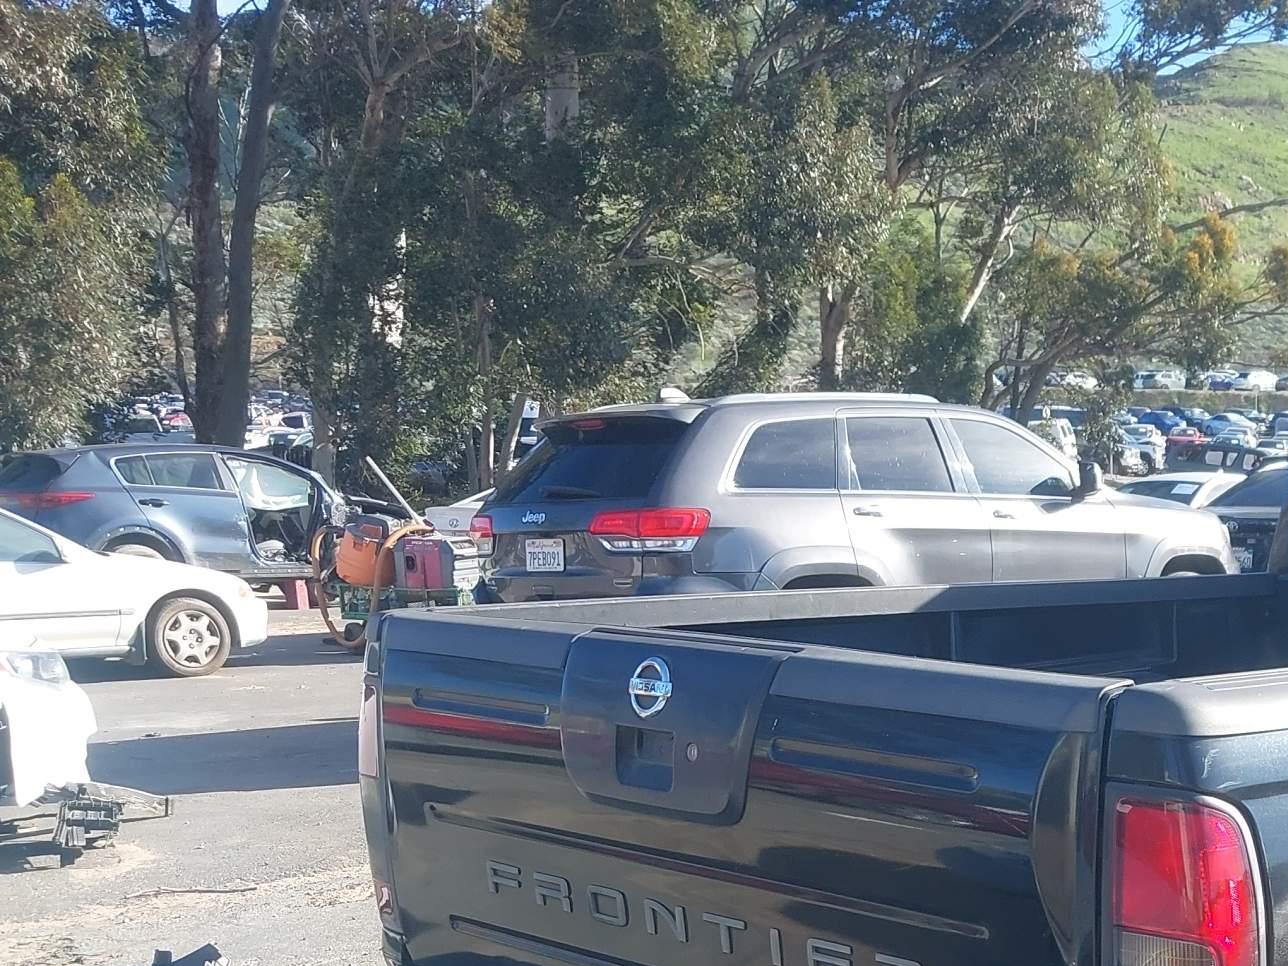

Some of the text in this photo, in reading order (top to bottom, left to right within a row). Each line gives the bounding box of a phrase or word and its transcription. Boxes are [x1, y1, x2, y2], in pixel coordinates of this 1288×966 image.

[522, 510, 546, 525] Jeep
[527, 551, 561, 567] 7PEB091
[630, 680, 671, 695] NISSAN
